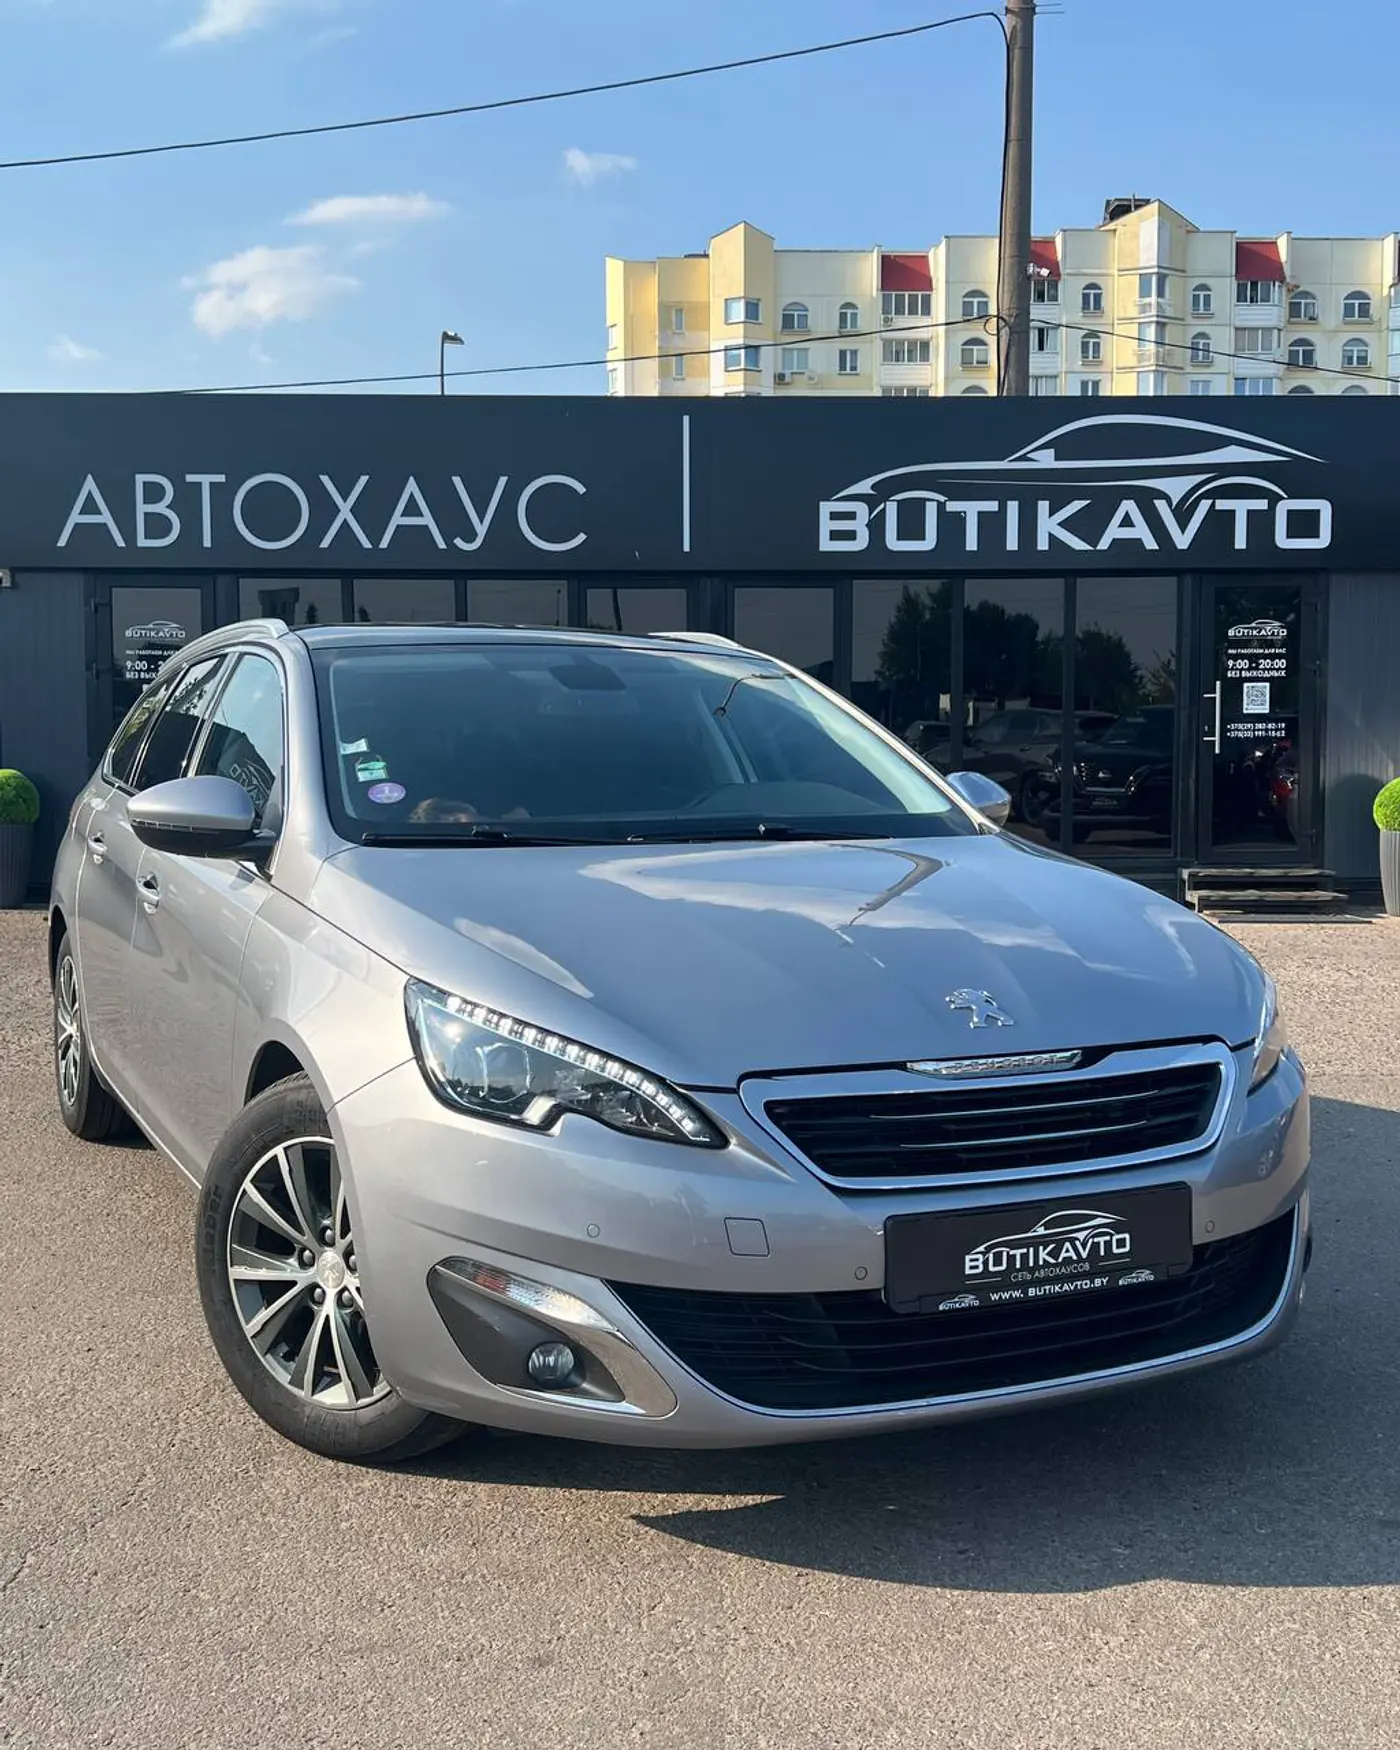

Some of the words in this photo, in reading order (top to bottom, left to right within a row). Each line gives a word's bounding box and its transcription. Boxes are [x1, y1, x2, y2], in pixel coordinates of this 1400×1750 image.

[57, 472, 588, 553] АВТОХАУС
[818, 497, 1333, 553] BUTIKAVTO
[125, 629, 186, 638] BUTIKAVTO
[1227, 628, 1288, 637] BUTIKAVTO
[125, 661, 148, 670] 9:00
[1227, 659, 1249, 669] 9:00
[1258, 659, 1287, 669] 20:00
[1227, 670, 1240, 678] БЕЗ
[1241, 670, 1287, 678] ВЫХОДНЫХ
[964, 1232, 1132, 1275] BUTIKAVTO
[1010, 1270, 1032, 1283] СЕТЬ
[1033, 1261, 1090, 1280] АВТОХАУСОВ
[1118, 1273, 1155, 1287] BUTIKAVTO
[989, 1289, 1024, 1302] WWW.
[1027, 1276, 1110, 1298] BUTIKAVTO.BY
[938, 1299, 980, 1312] BUTIKAVTO
